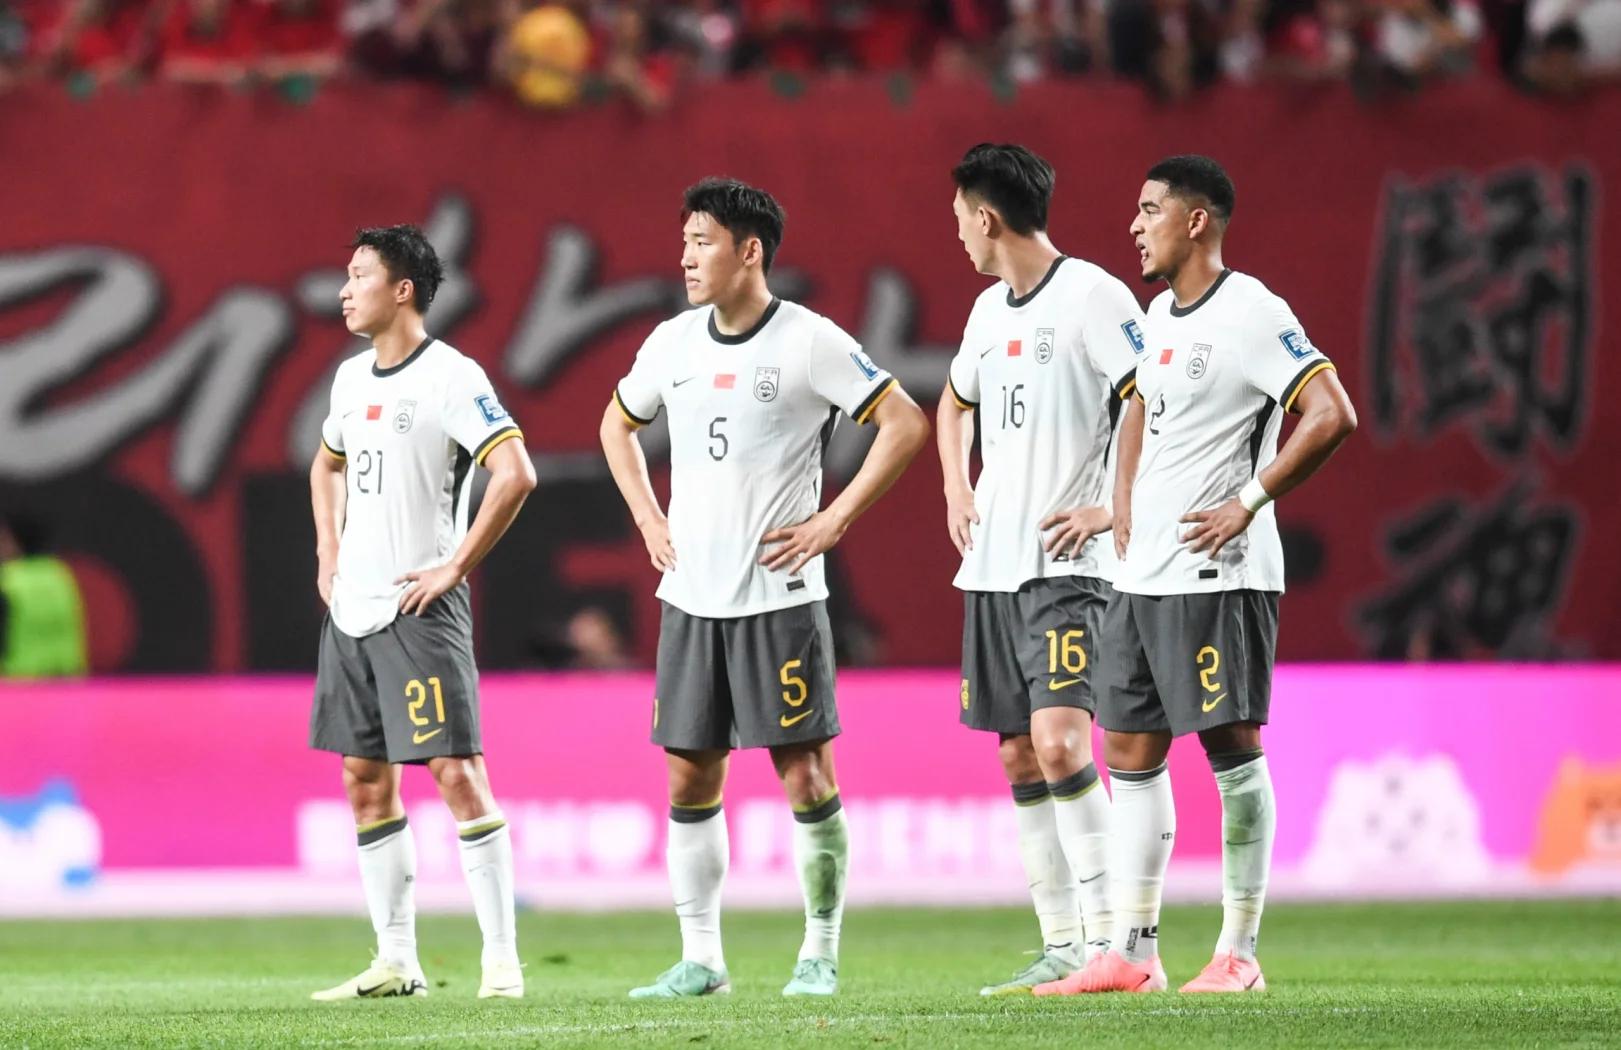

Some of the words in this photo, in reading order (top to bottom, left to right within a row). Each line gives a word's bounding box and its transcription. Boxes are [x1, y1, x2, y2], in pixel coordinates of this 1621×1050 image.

[1002, 384, 1025, 430] 16
[1149, 393, 1166, 436] 2
[708, 416, 729, 462] 5
[356, 449, 384, 495] 21
[1045, 629, 1088, 674] 16
[1196, 645, 1220, 693] 2
[405, 676, 446, 726] 21
[779, 659, 808, 707] 5
